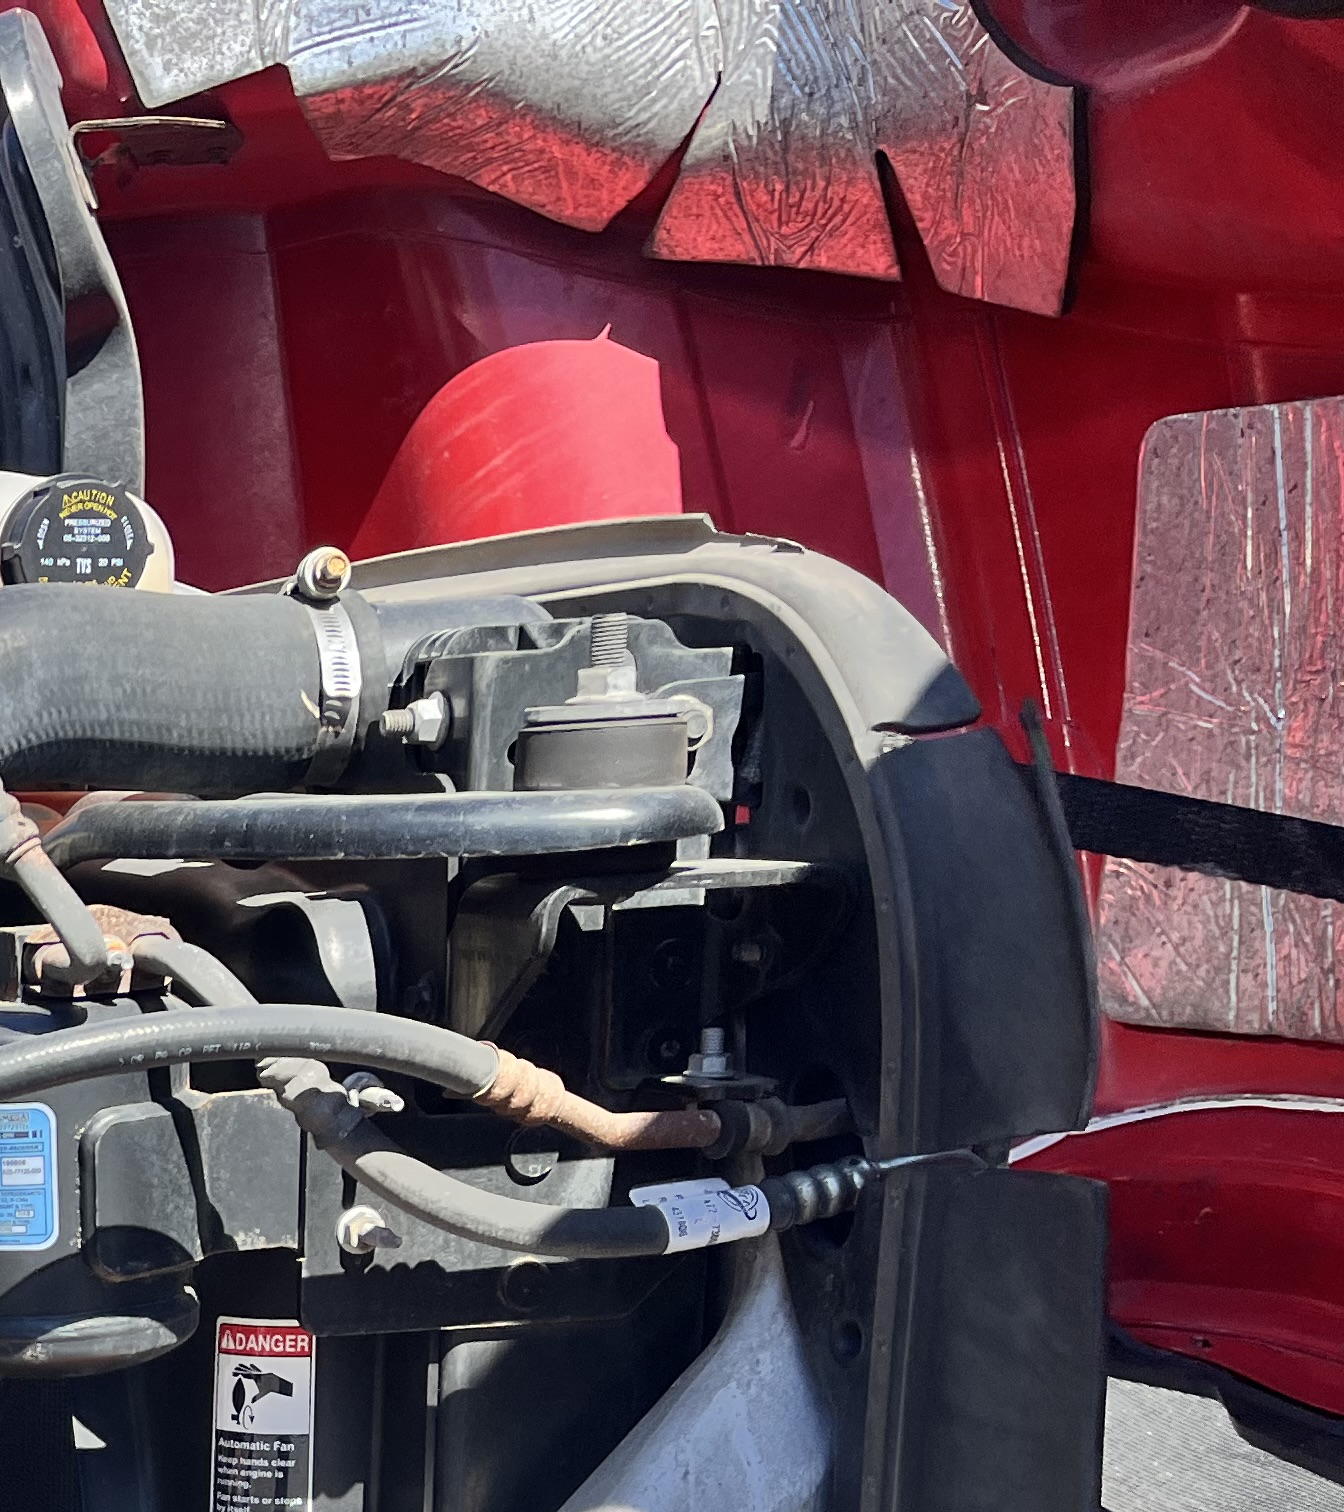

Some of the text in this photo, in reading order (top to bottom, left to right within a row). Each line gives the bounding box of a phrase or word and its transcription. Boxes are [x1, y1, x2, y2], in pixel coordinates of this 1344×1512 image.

[72, 489, 115, 506] CAUTION
[59, 503, 83, 519] NEVER
[84, 501, 104, 512] OPEN
[76, 558, 92, 574] TVS
[111, 557, 124, 567] PSI
[235, 1333, 310, 1353] DANGER
[218, 1437, 295, 1452] Automatic Fan
[218, 1455, 296, 1467] Keep hands clear
[218, 1466, 284, 1479] when engine is
[217, 1478, 252, 1489] running.
[217, 1491, 303, 1507] Fan starts or stops
[217, 1503, 226, 1512] by
